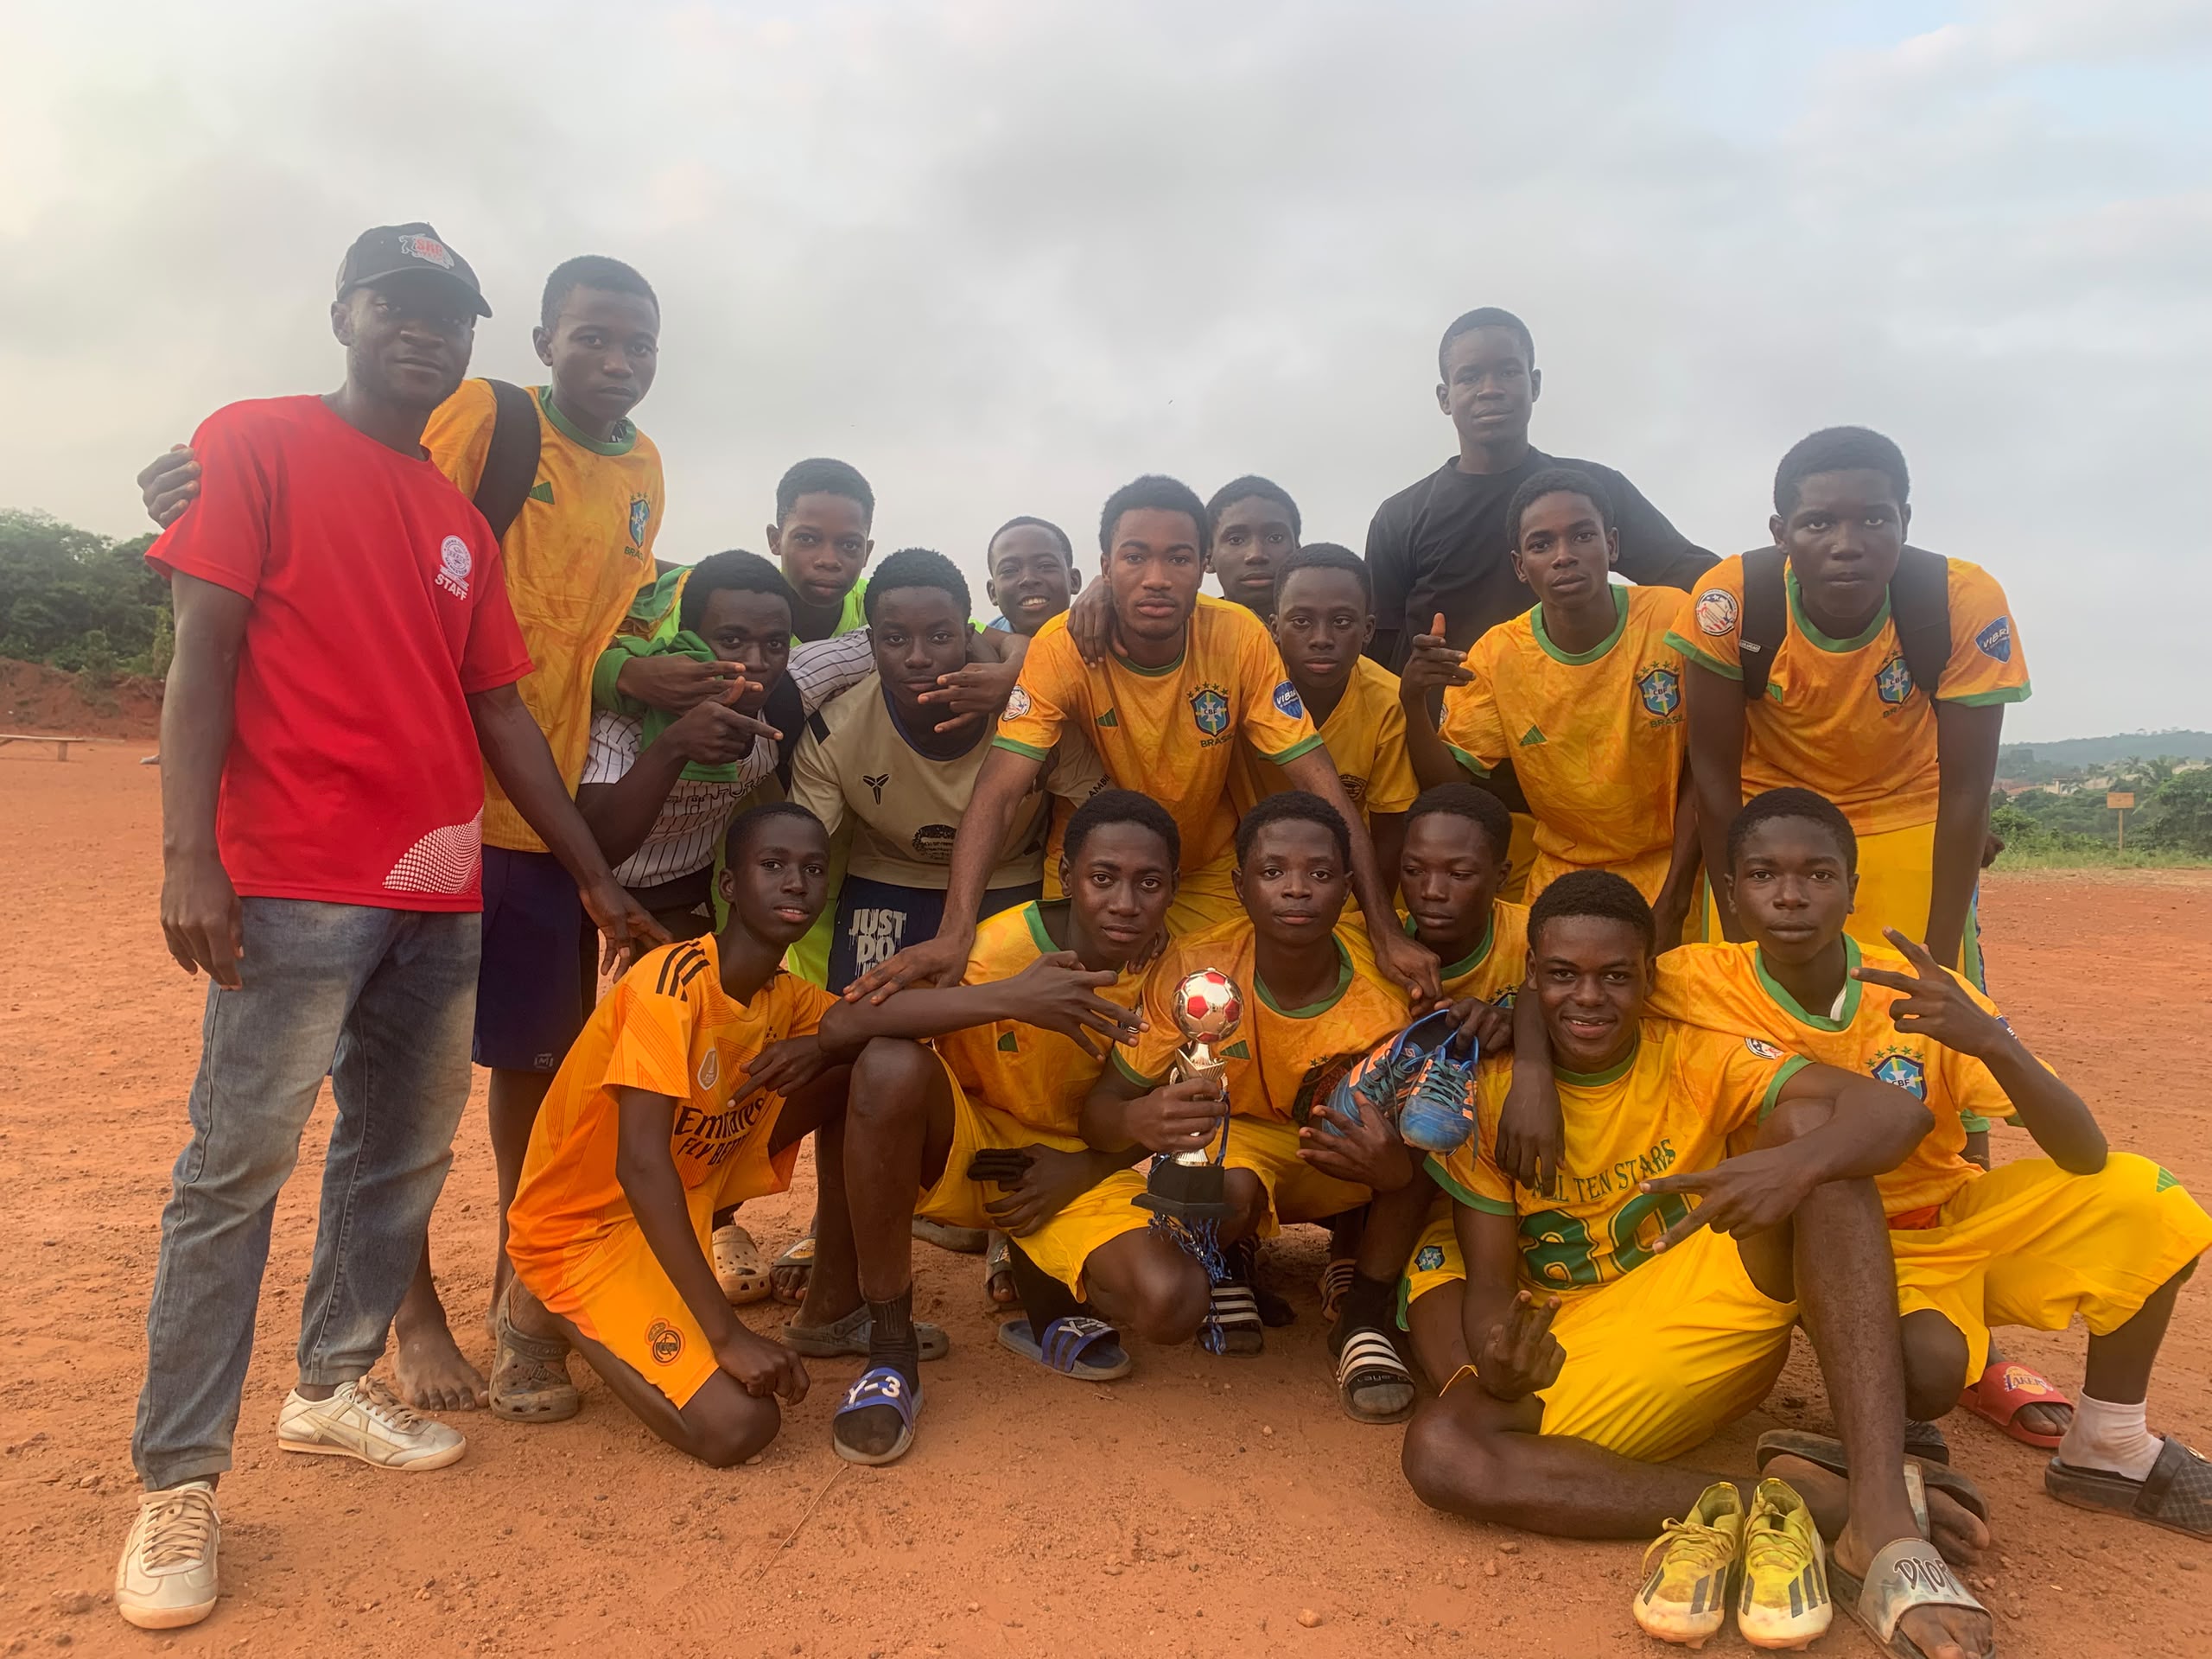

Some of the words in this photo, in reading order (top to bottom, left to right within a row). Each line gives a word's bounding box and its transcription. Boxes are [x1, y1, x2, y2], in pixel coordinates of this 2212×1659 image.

[434, 573, 468, 601] STAFF
[849, 908, 907, 940] JUST
[856, 935, 895, 964] DO
[674, 1097, 765, 1139] Emirates
[677, 1137, 715, 1160] FLY
[1573, 1168, 1613, 1203] TEN
[1614, 1138, 1676, 1190] STARS
[849, 1376, 901, 1405] Y-3
